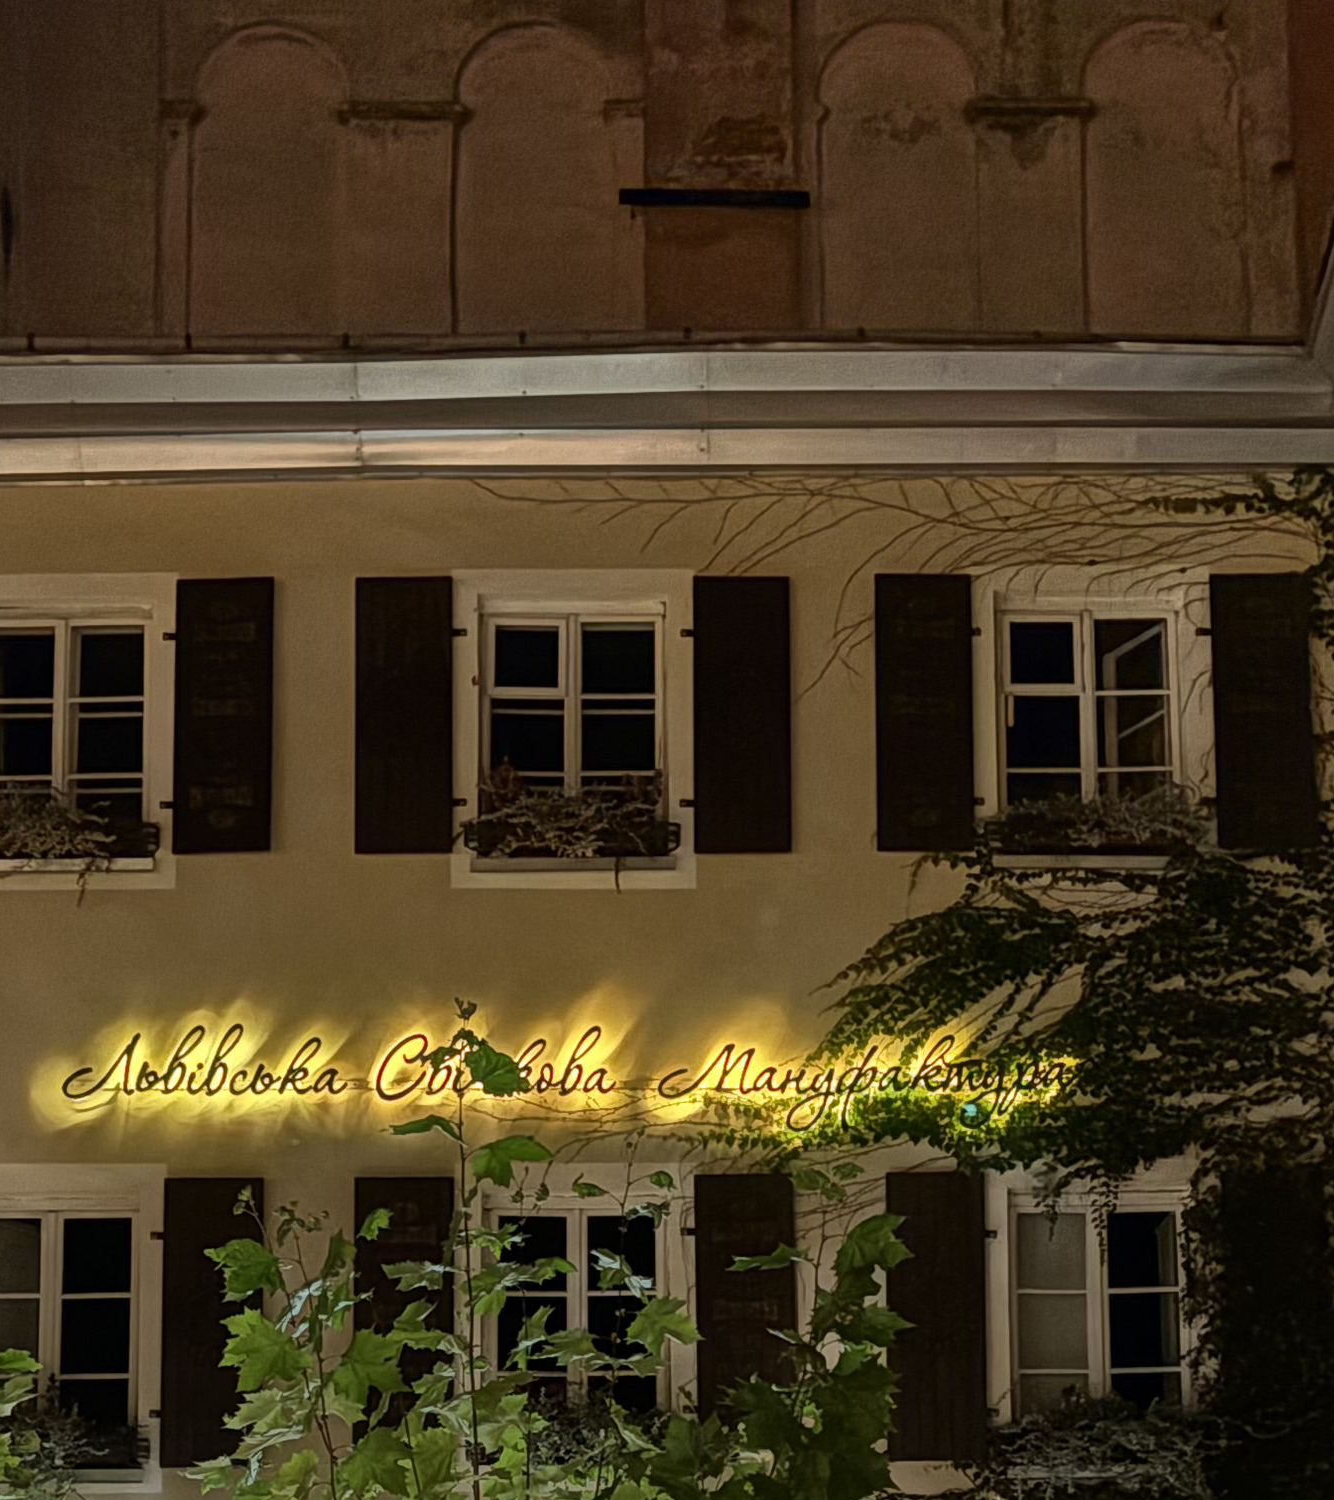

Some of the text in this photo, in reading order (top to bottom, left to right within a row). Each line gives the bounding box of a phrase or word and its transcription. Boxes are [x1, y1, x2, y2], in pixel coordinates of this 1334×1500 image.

[62, 1023, 1076, 1132] Львівська Свікова Мануфактура
